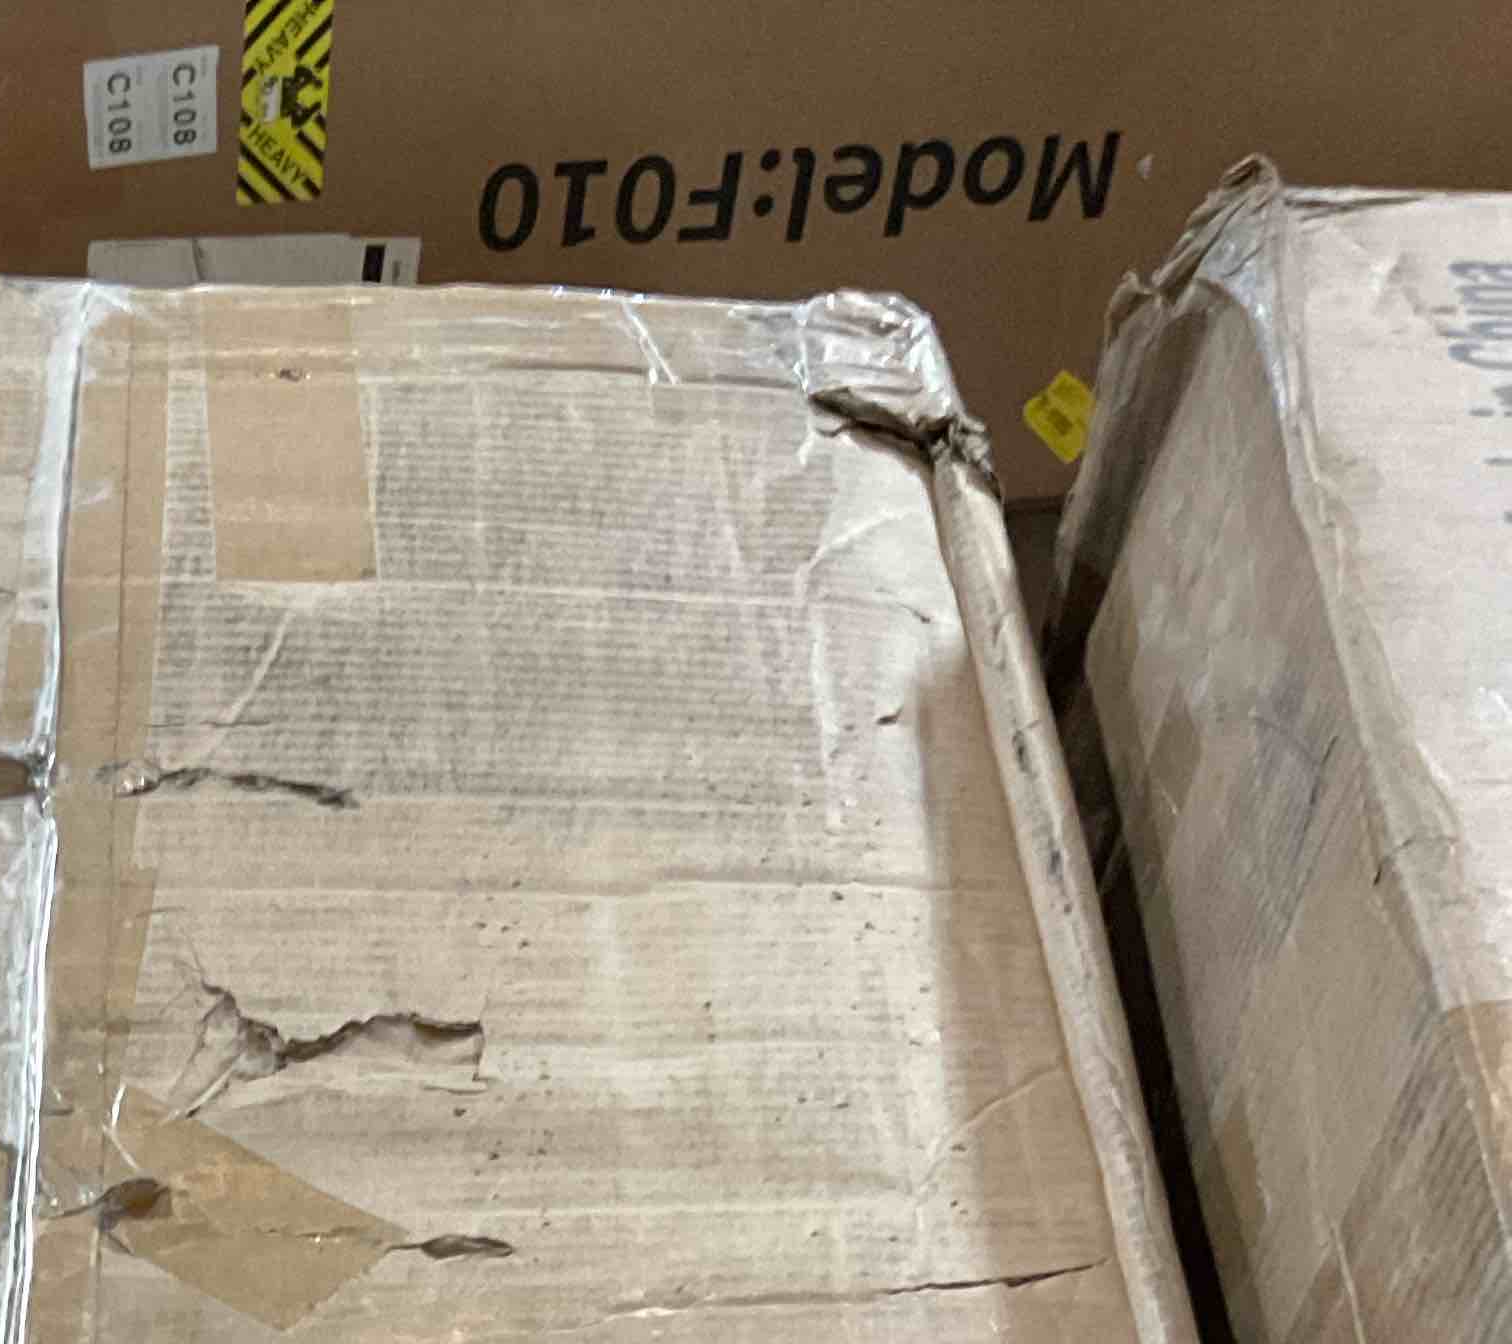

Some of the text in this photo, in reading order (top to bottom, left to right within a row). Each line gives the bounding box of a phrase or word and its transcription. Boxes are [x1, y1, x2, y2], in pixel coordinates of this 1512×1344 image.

[105, 71, 134, 156] C108
[171, 62, 198, 147] C108
[246, 125, 308, 185] HEAVY
[477, 131, 1122, 253] Model:F010
